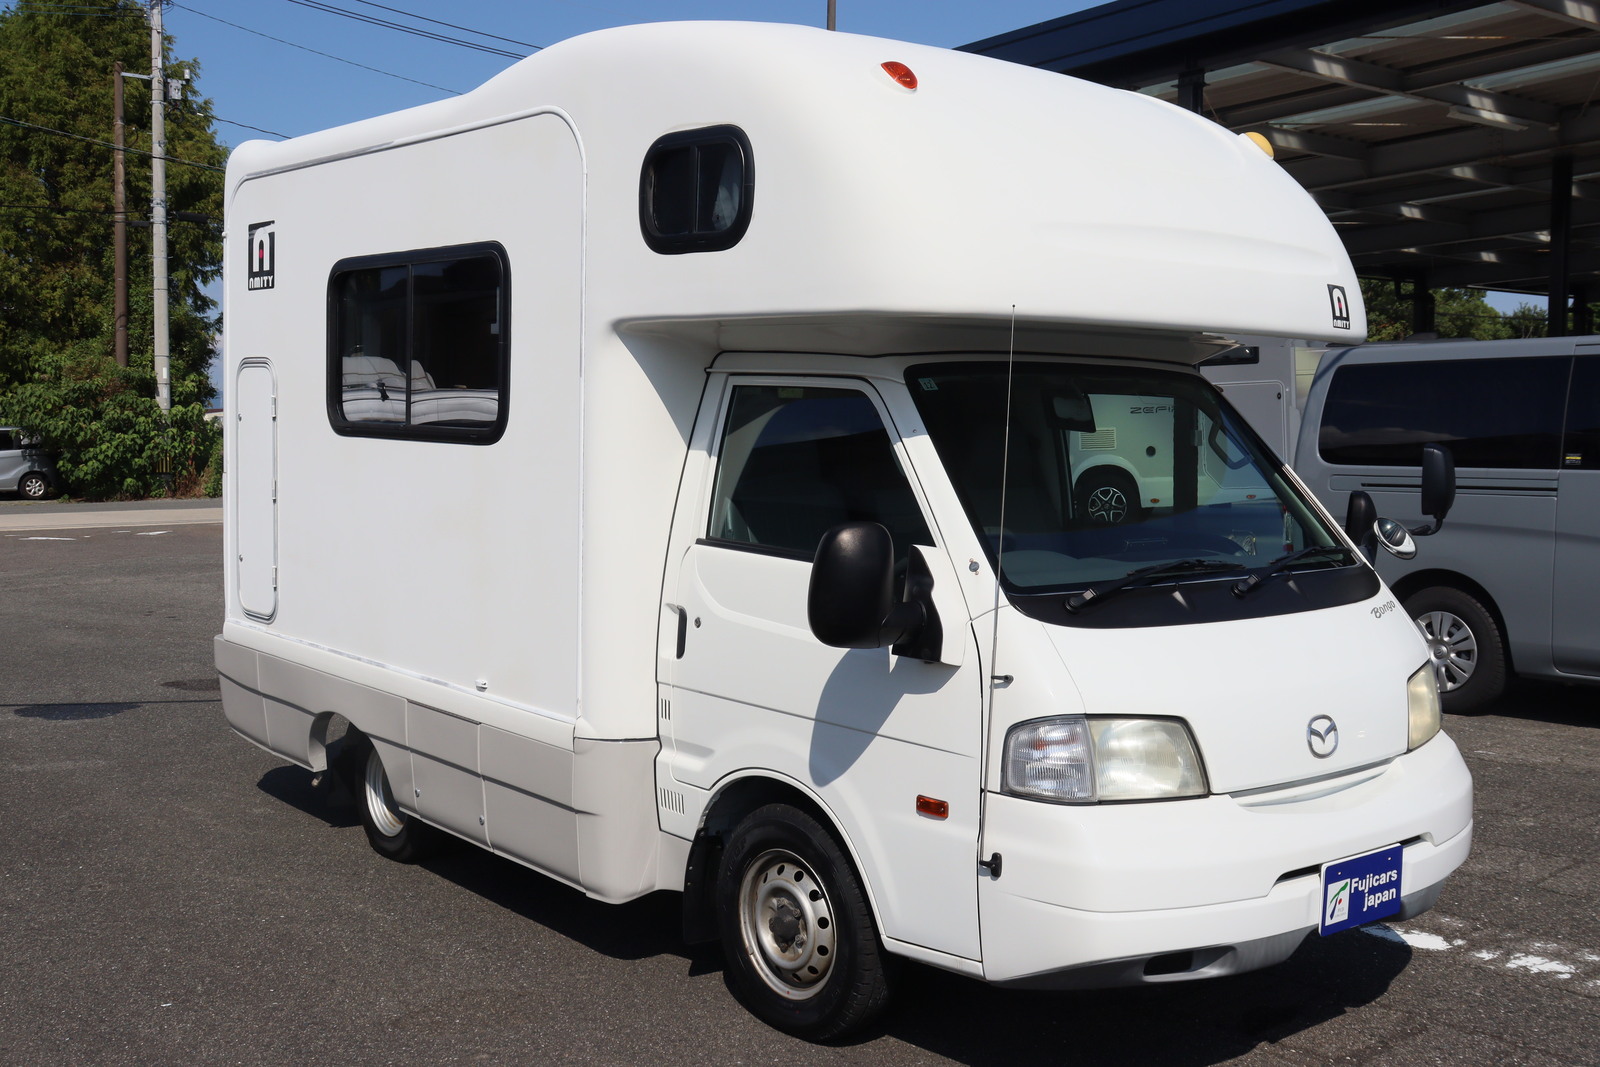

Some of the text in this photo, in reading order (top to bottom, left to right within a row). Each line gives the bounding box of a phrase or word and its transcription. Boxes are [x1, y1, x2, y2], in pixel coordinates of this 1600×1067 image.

[1370, 600, 1395, 618] Bongo
[1351, 870, 1397, 893] Fujicars
[1363, 888, 1396, 911] japan
